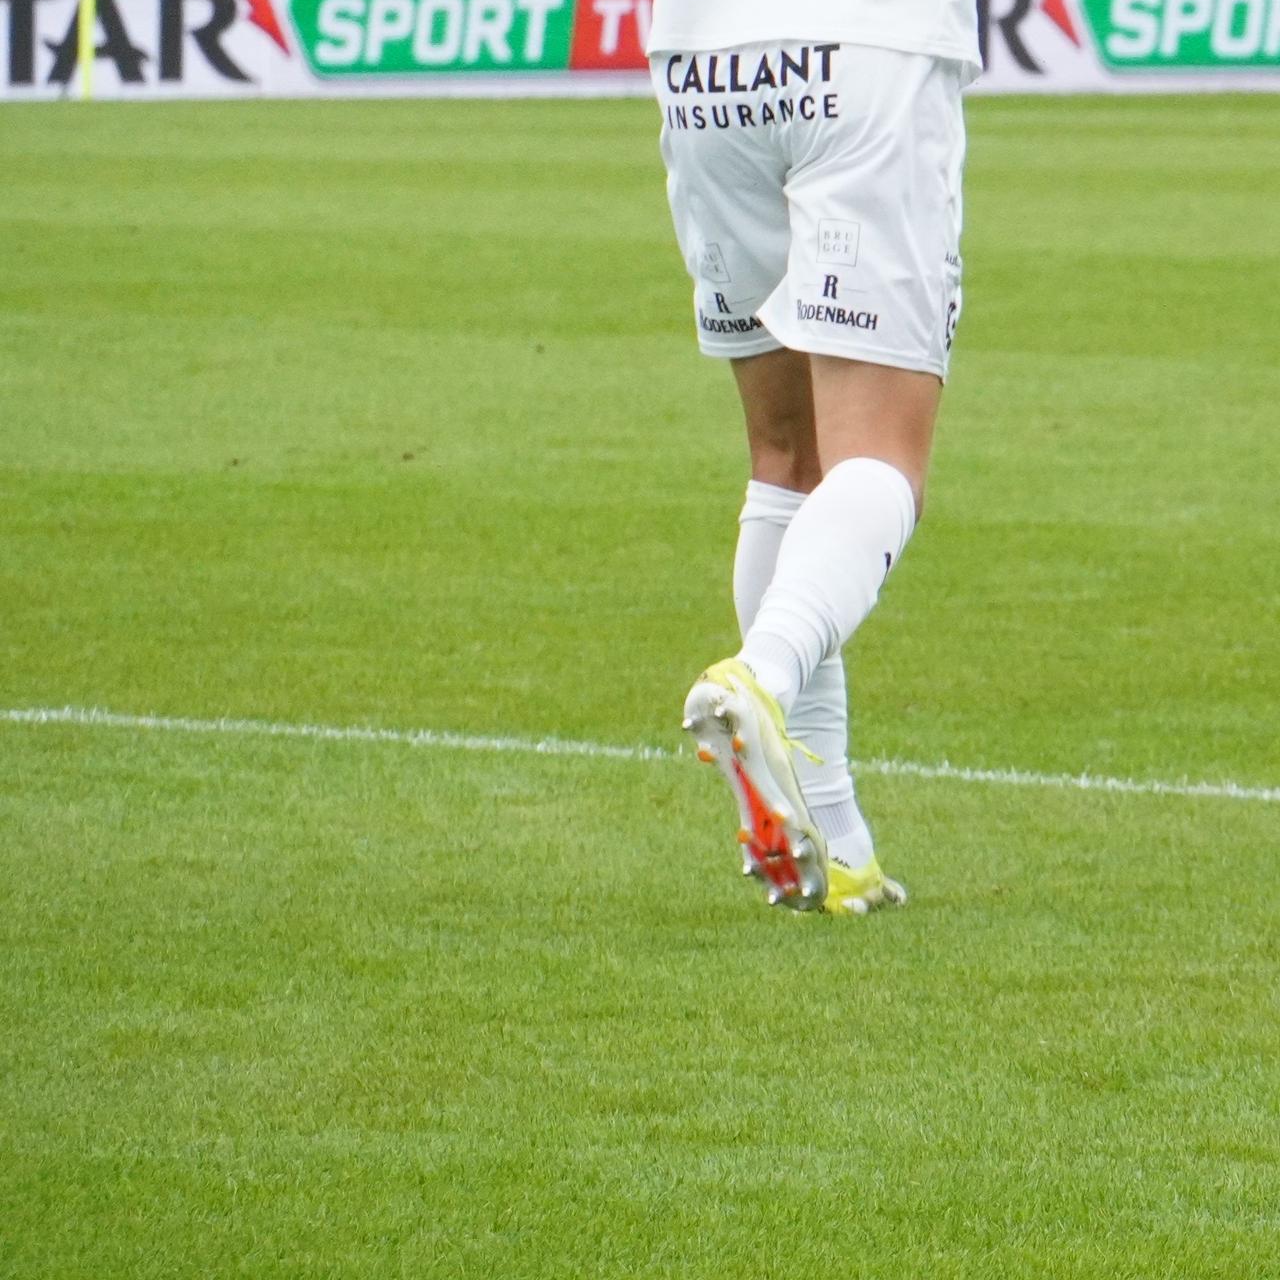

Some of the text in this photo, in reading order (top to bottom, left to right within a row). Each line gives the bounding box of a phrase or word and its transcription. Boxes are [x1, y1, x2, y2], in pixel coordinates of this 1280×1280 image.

[667, 44, 840, 93] CALLANT
[668, 94, 839, 131] INSURANCE
[822, 275, 838, 299] R
[714, 292, 732, 314] R
